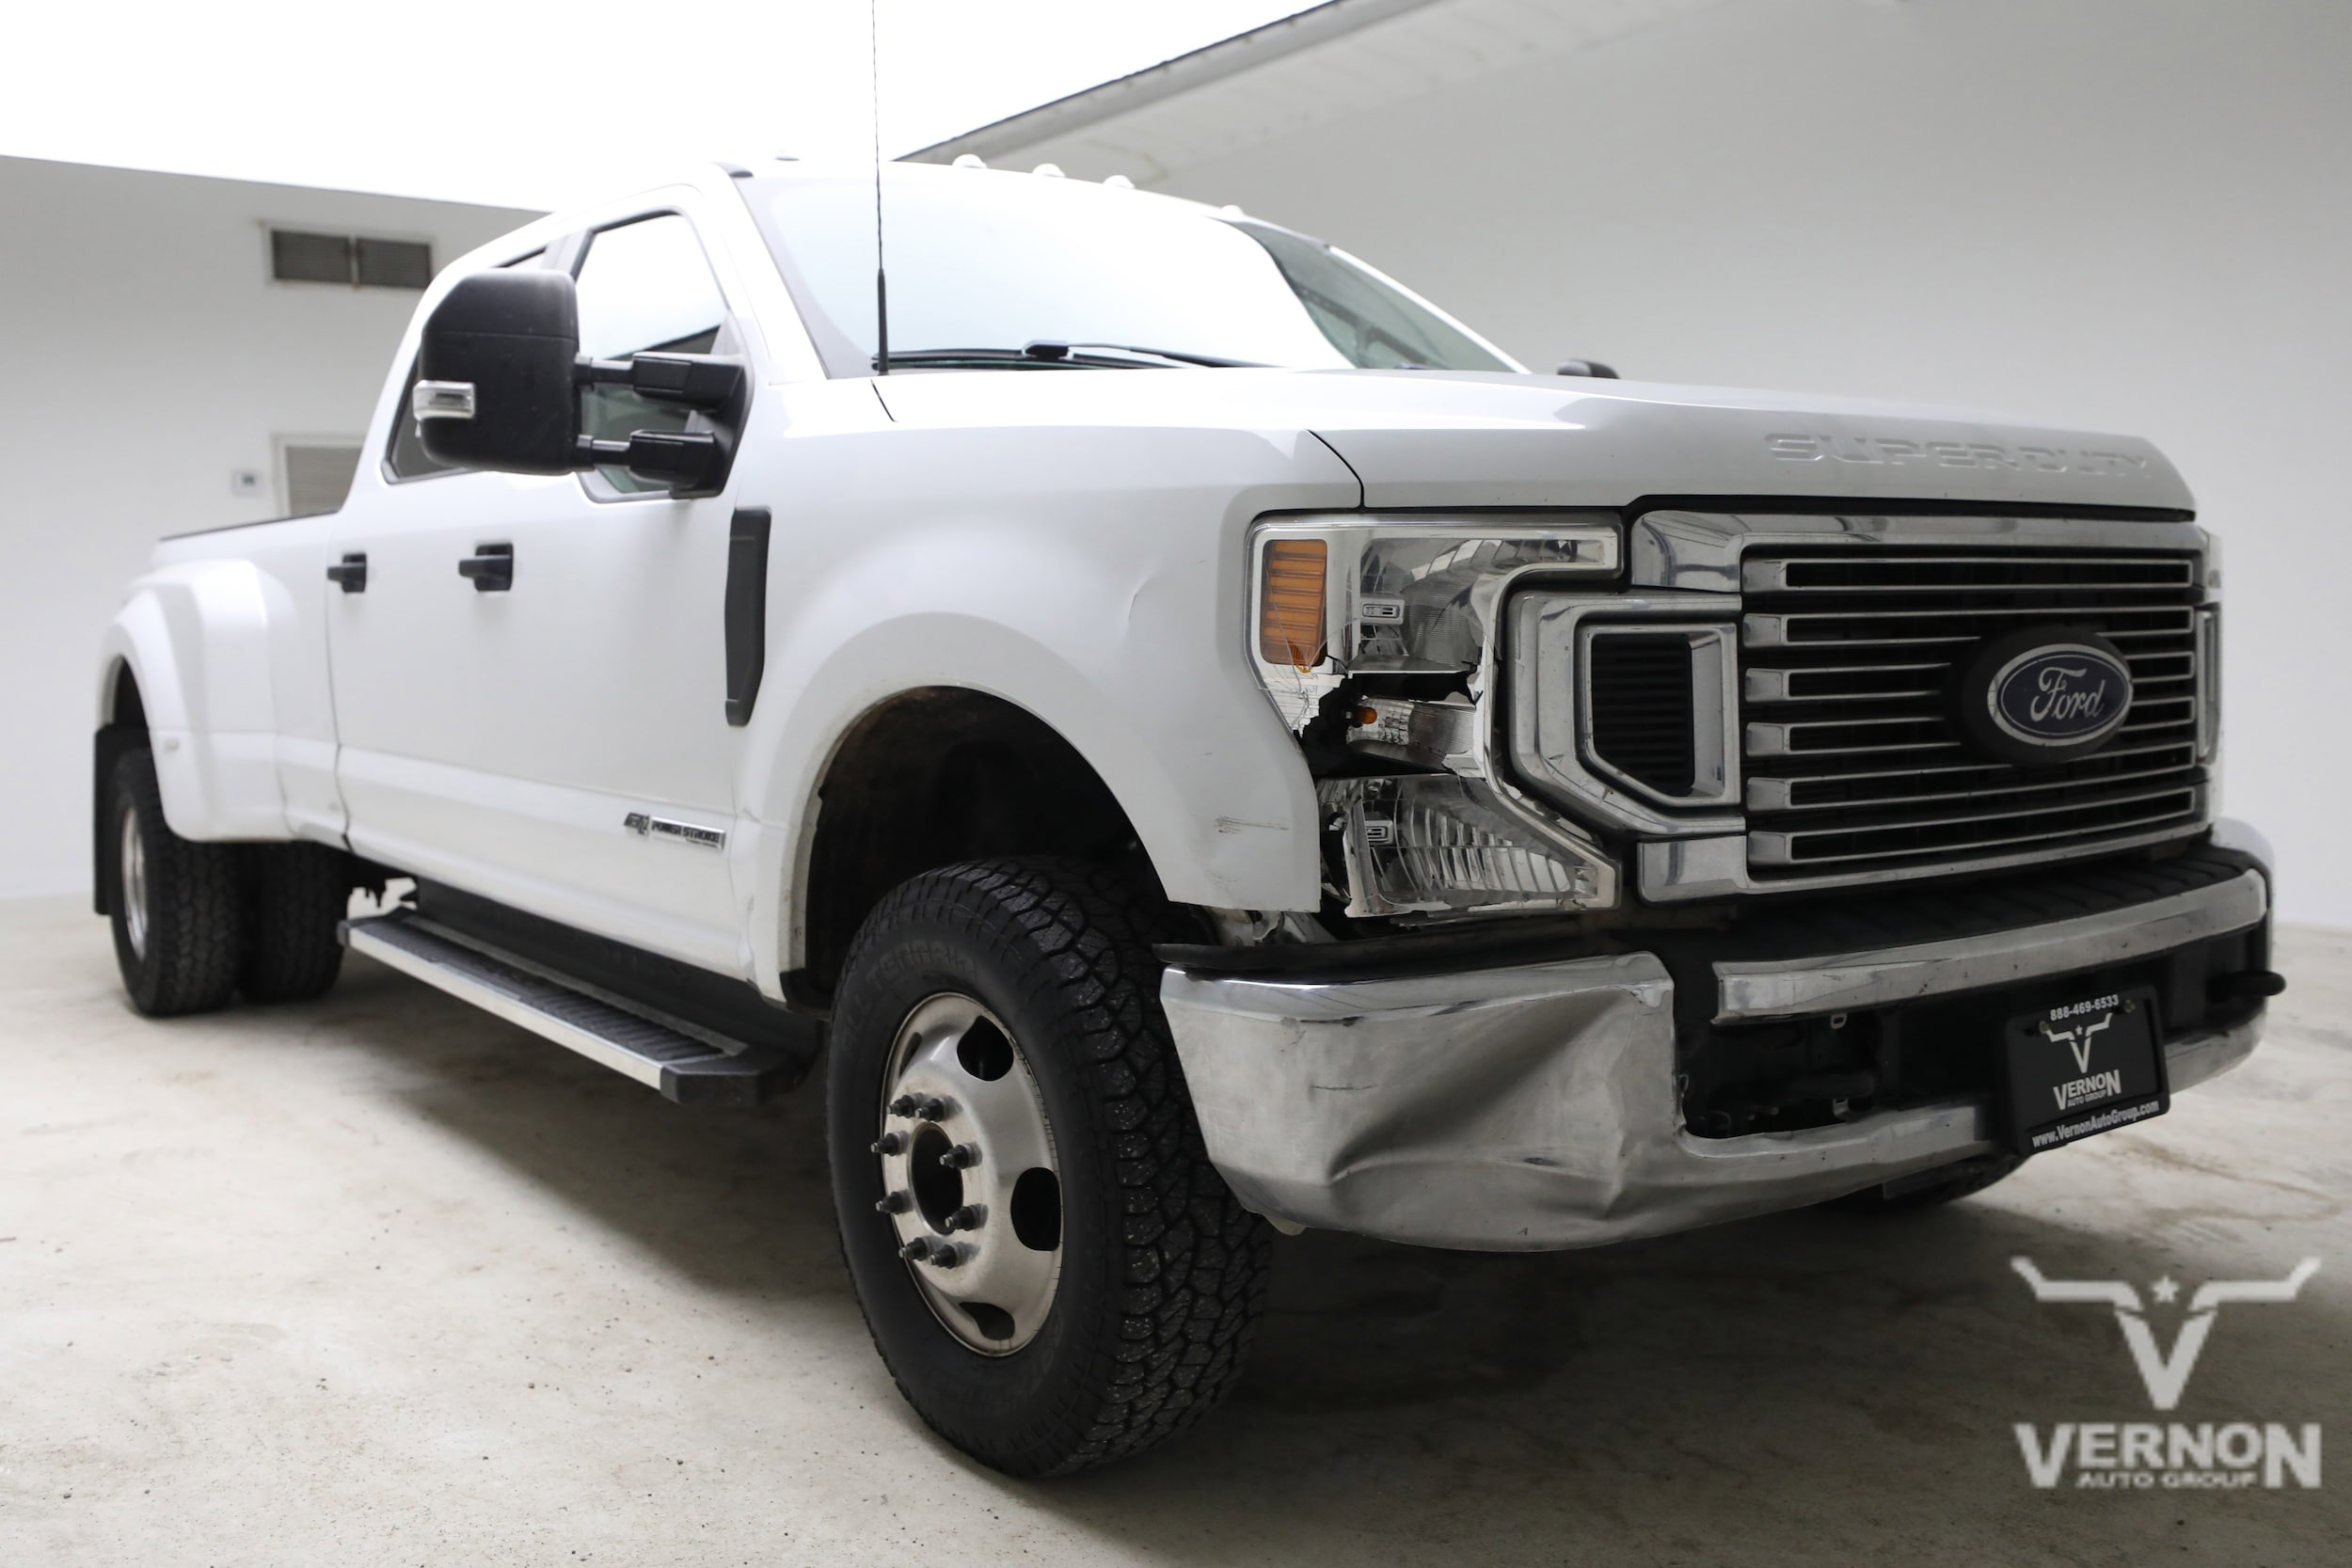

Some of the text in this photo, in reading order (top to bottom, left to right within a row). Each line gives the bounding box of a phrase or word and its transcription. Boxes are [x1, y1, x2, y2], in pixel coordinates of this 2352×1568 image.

[1764, 433, 2020, 470] SUPER
[2029, 666, 2106, 722] Ford
[2049, 993, 2120, 1022] 888-469-6533
[2052, 1069, 2122, 1111] VERNON
[2067, 1089, 2107, 1108] AUTO GROUP
[2031, 1100, 2160, 1148] www.VernonAutoGroup.com
